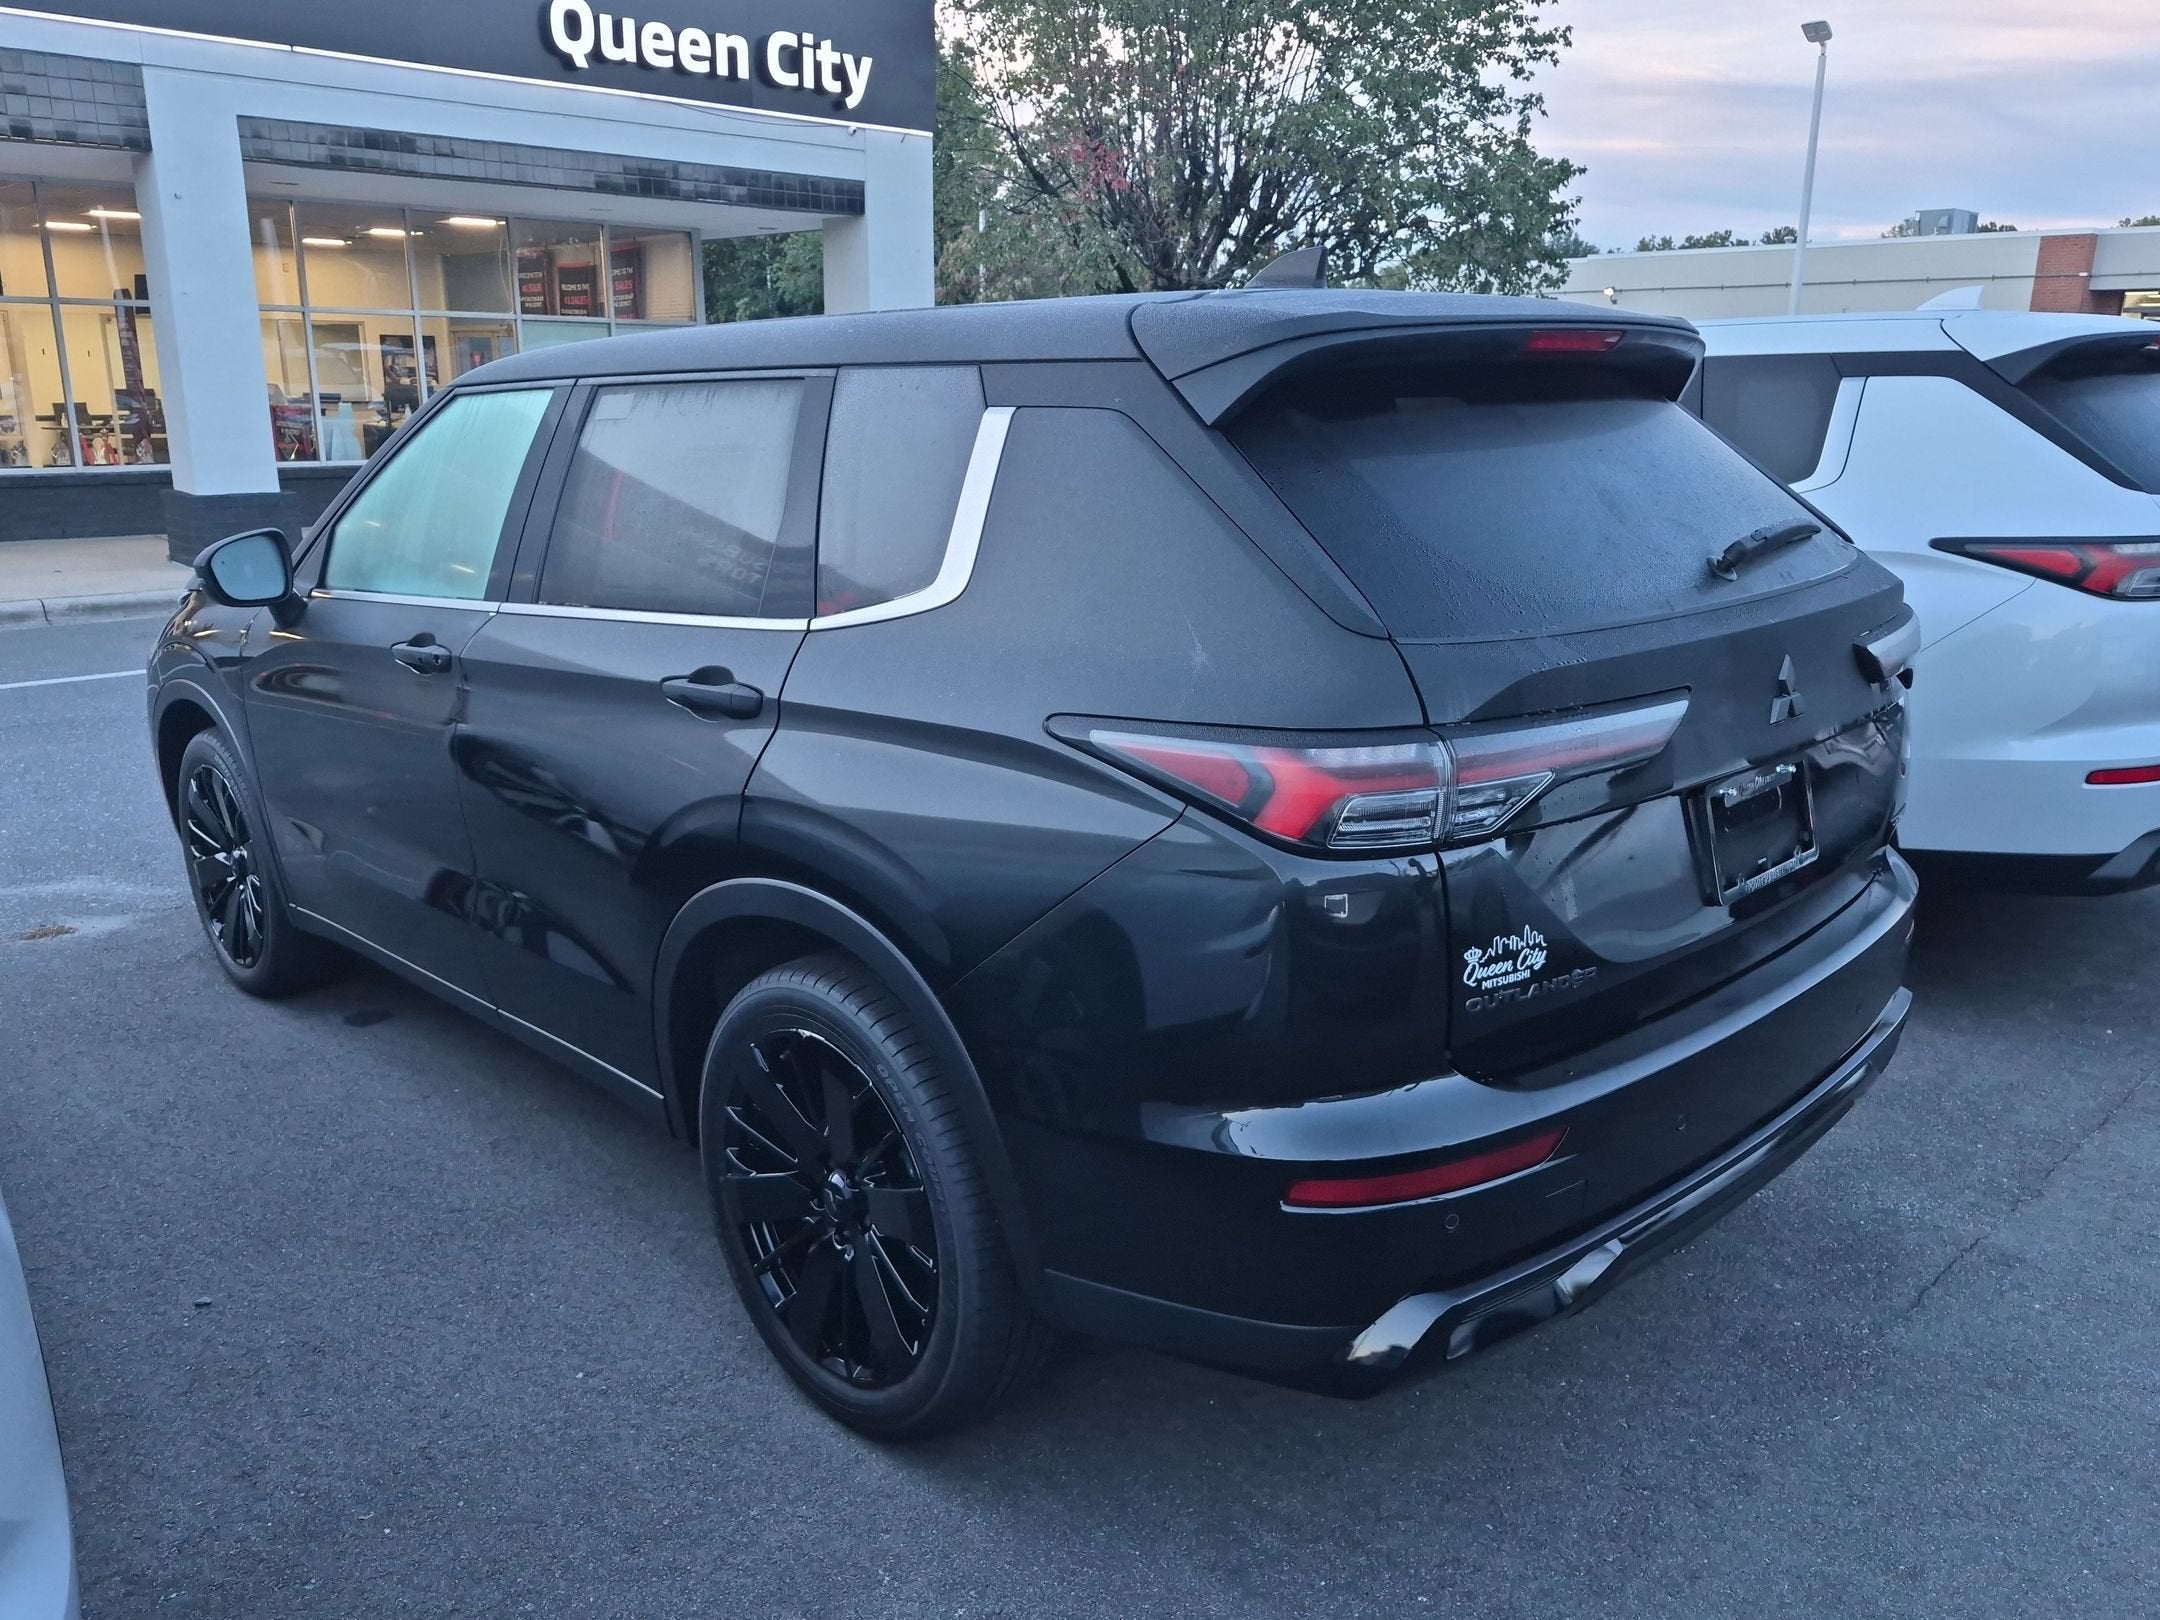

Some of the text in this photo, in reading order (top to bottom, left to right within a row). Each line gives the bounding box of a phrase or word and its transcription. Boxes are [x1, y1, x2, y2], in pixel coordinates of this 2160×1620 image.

[549, 0, 873, 110] Queen City
[1463, 947, 1548, 987] Queen City
[1481, 969, 1531, 991] MITSUBISHI
[1465, 966, 1598, 1012] OUTLANDER
